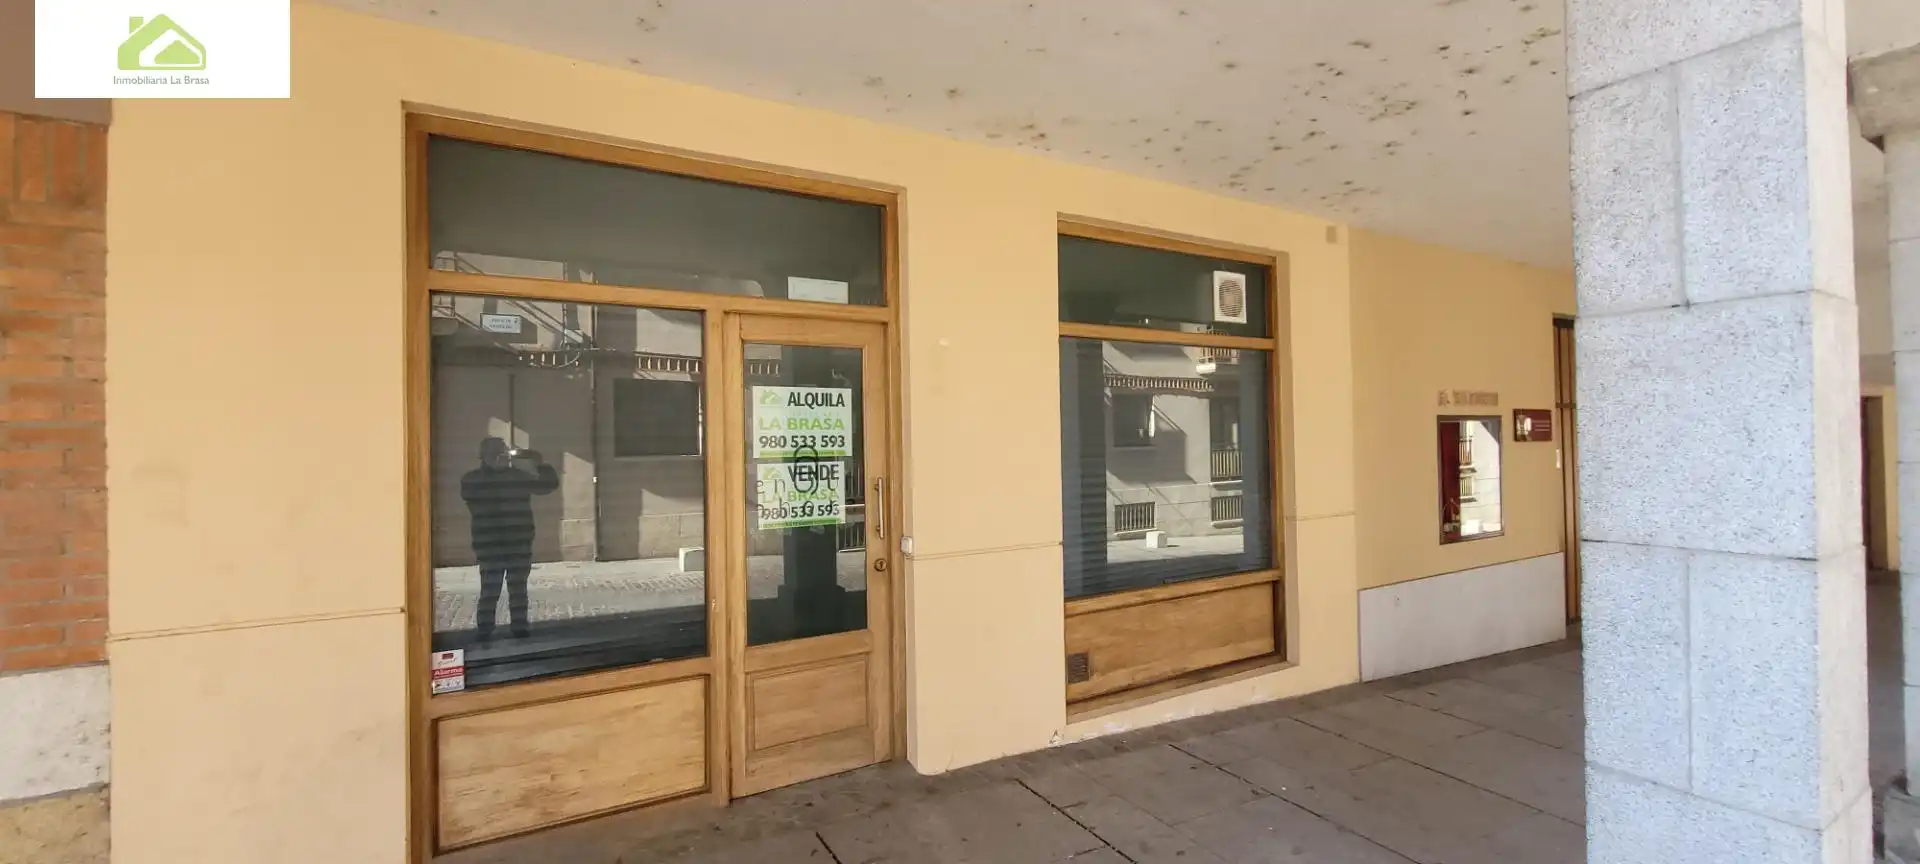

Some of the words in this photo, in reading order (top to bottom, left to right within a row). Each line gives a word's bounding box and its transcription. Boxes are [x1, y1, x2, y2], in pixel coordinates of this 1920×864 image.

[787, 391, 845, 409] ALQUILA
[759, 416, 781, 430] LA
[787, 417, 845, 430] BRASA
[759, 435, 787, 448] 980
[790, 435, 816, 448] 533
[820, 435, 845, 448] 593
[787, 464, 840, 482] VENDE
[762, 507, 787, 520] 980
[790, 505, 814, 518] 533
[817, 504, 839, 517] 593
